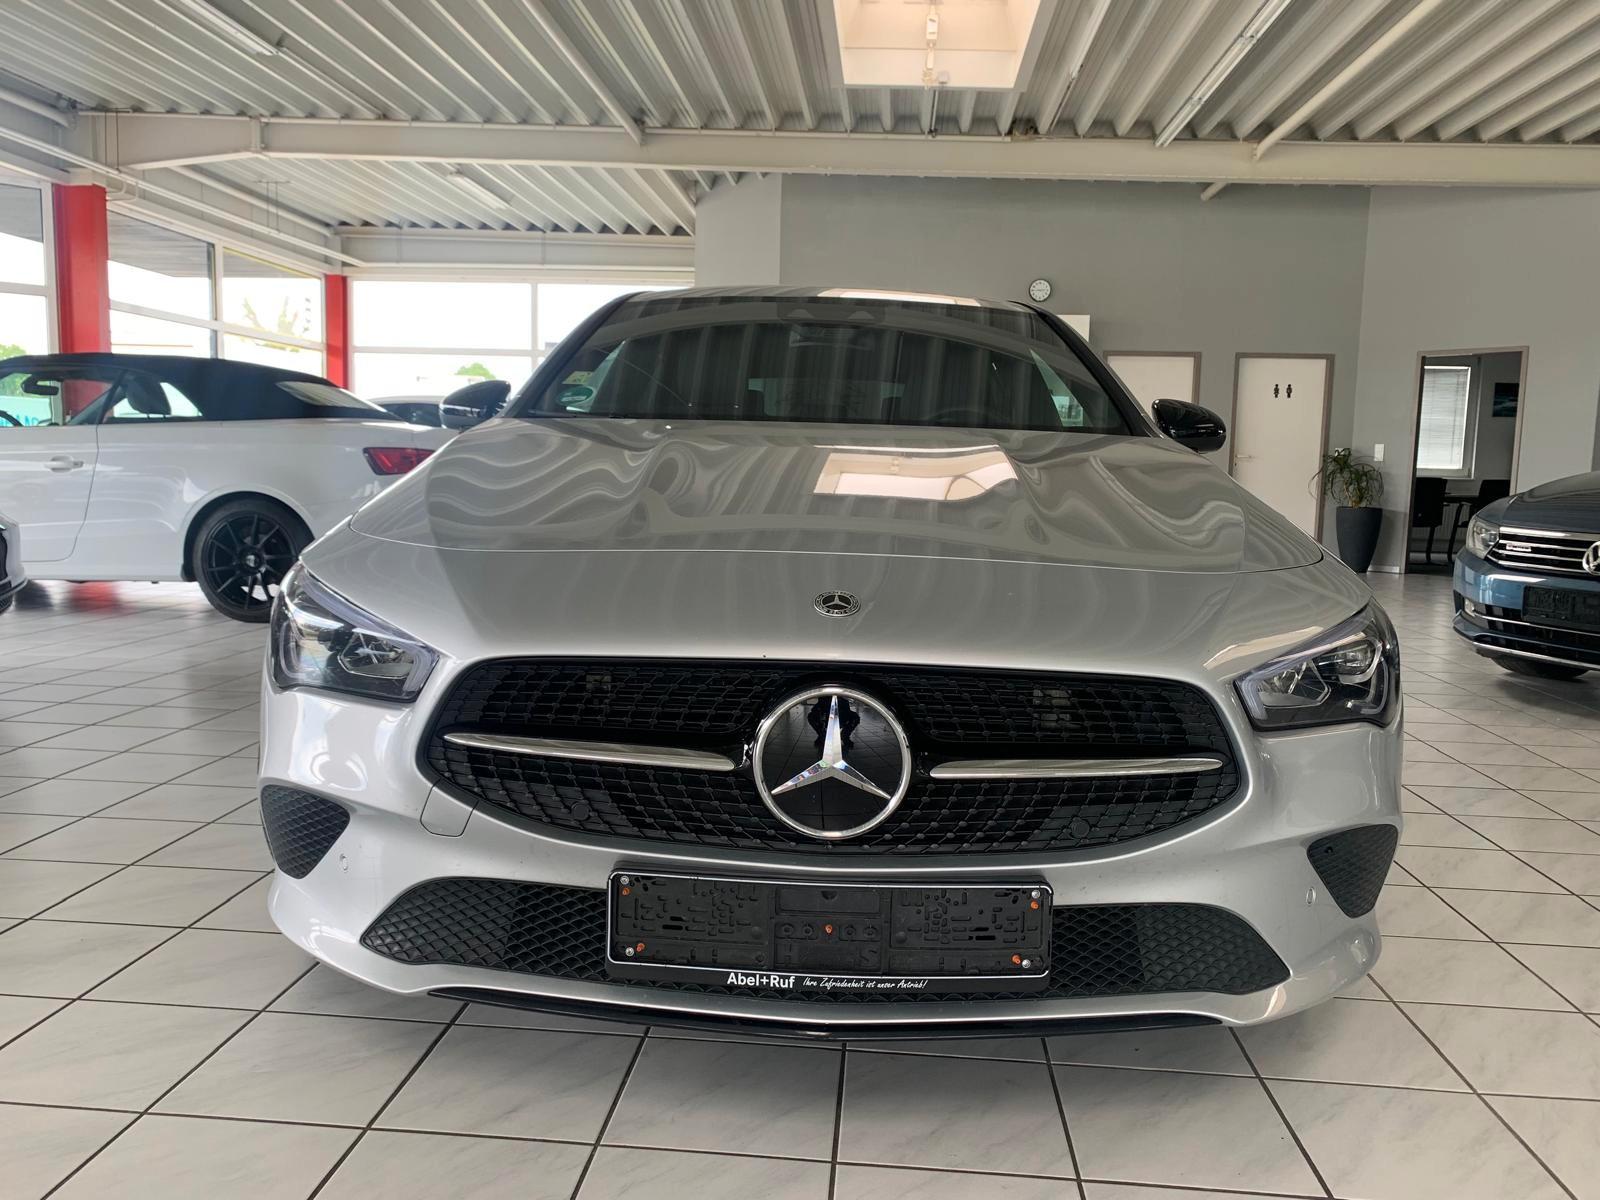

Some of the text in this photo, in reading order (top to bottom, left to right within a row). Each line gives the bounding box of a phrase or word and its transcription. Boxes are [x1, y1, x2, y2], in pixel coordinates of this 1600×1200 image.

[727, 972, 796, 988] Abel+Ruf
[803, 977, 818, 987] Ihre
[819, 977, 865, 990] Zufriedenheit
[866, 980, 877, 989] ist
[897, 979, 928, 989] Antrieb!
